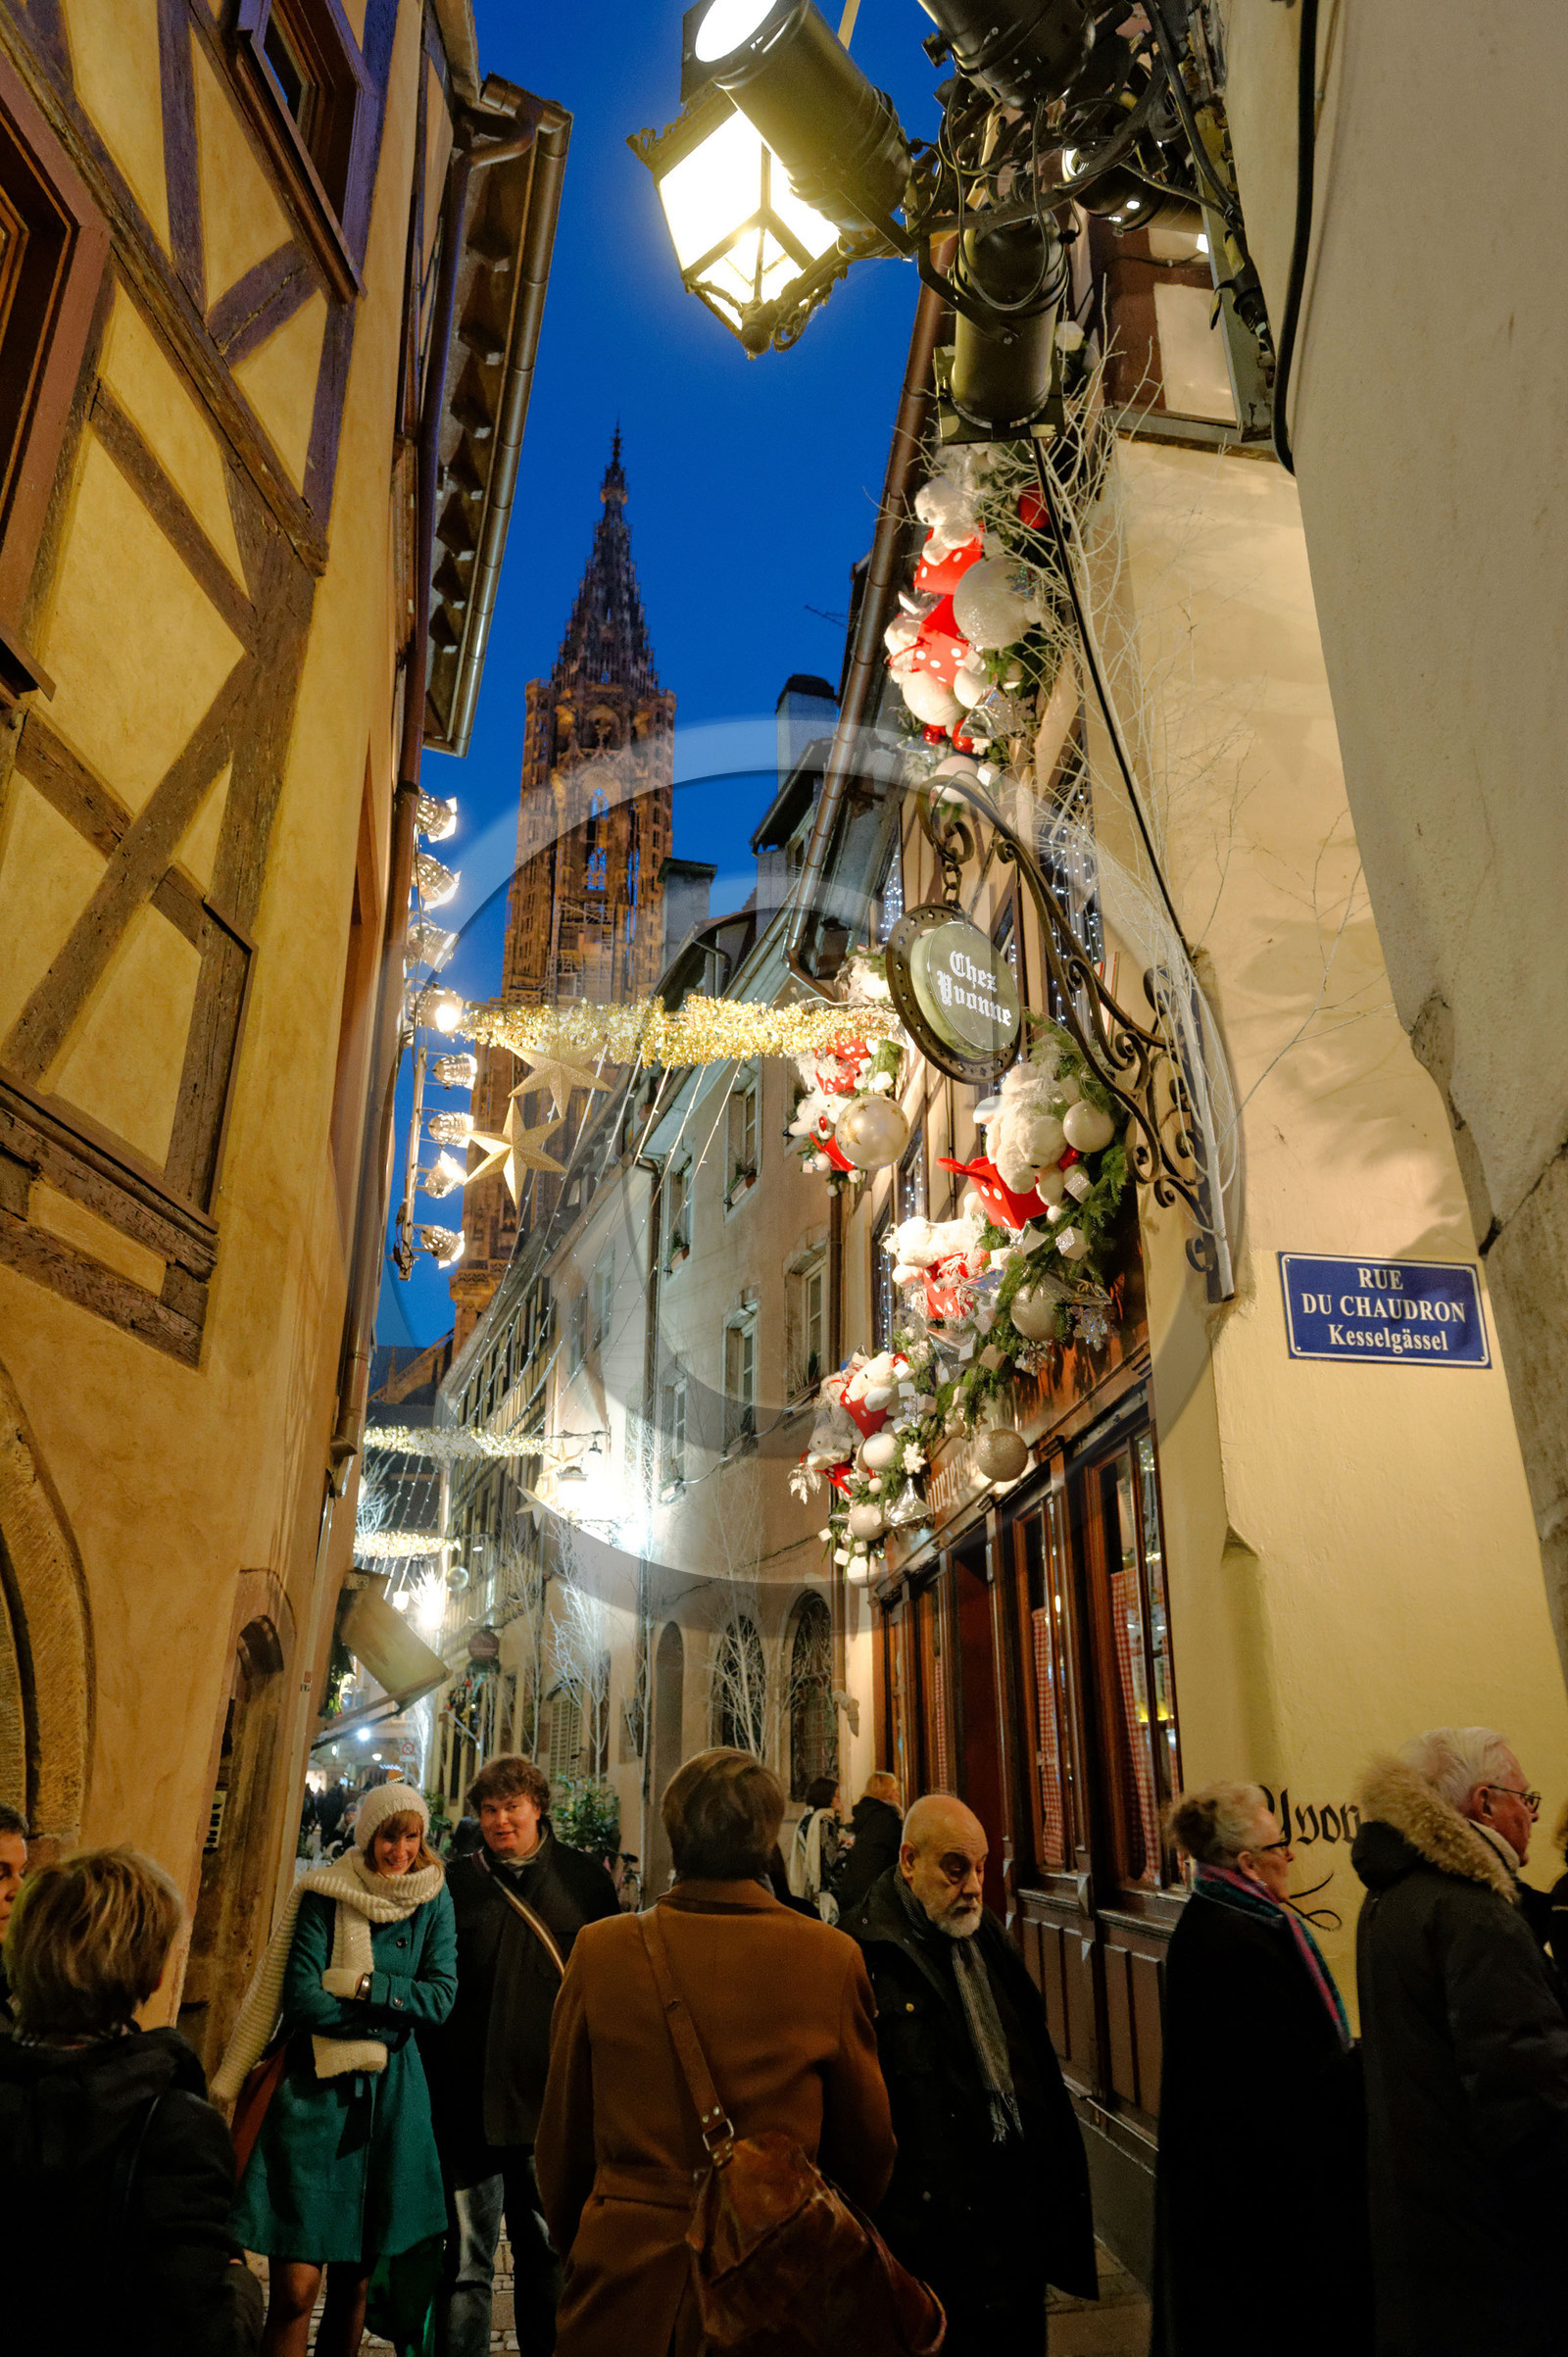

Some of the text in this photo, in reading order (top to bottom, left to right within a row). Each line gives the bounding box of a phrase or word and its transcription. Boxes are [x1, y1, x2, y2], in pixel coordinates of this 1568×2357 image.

[949, 950, 998, 993] Chez
[936, 969, 1013, 1027] Yvonne
[1357, 1267, 1403, 1291] RUE
[1300, 1293, 1467, 1323] DU CHAUDRON
[1328, 1323, 1449, 1354] Kesselgässel
[1259, 1785, 1360, 1845] Yvon
